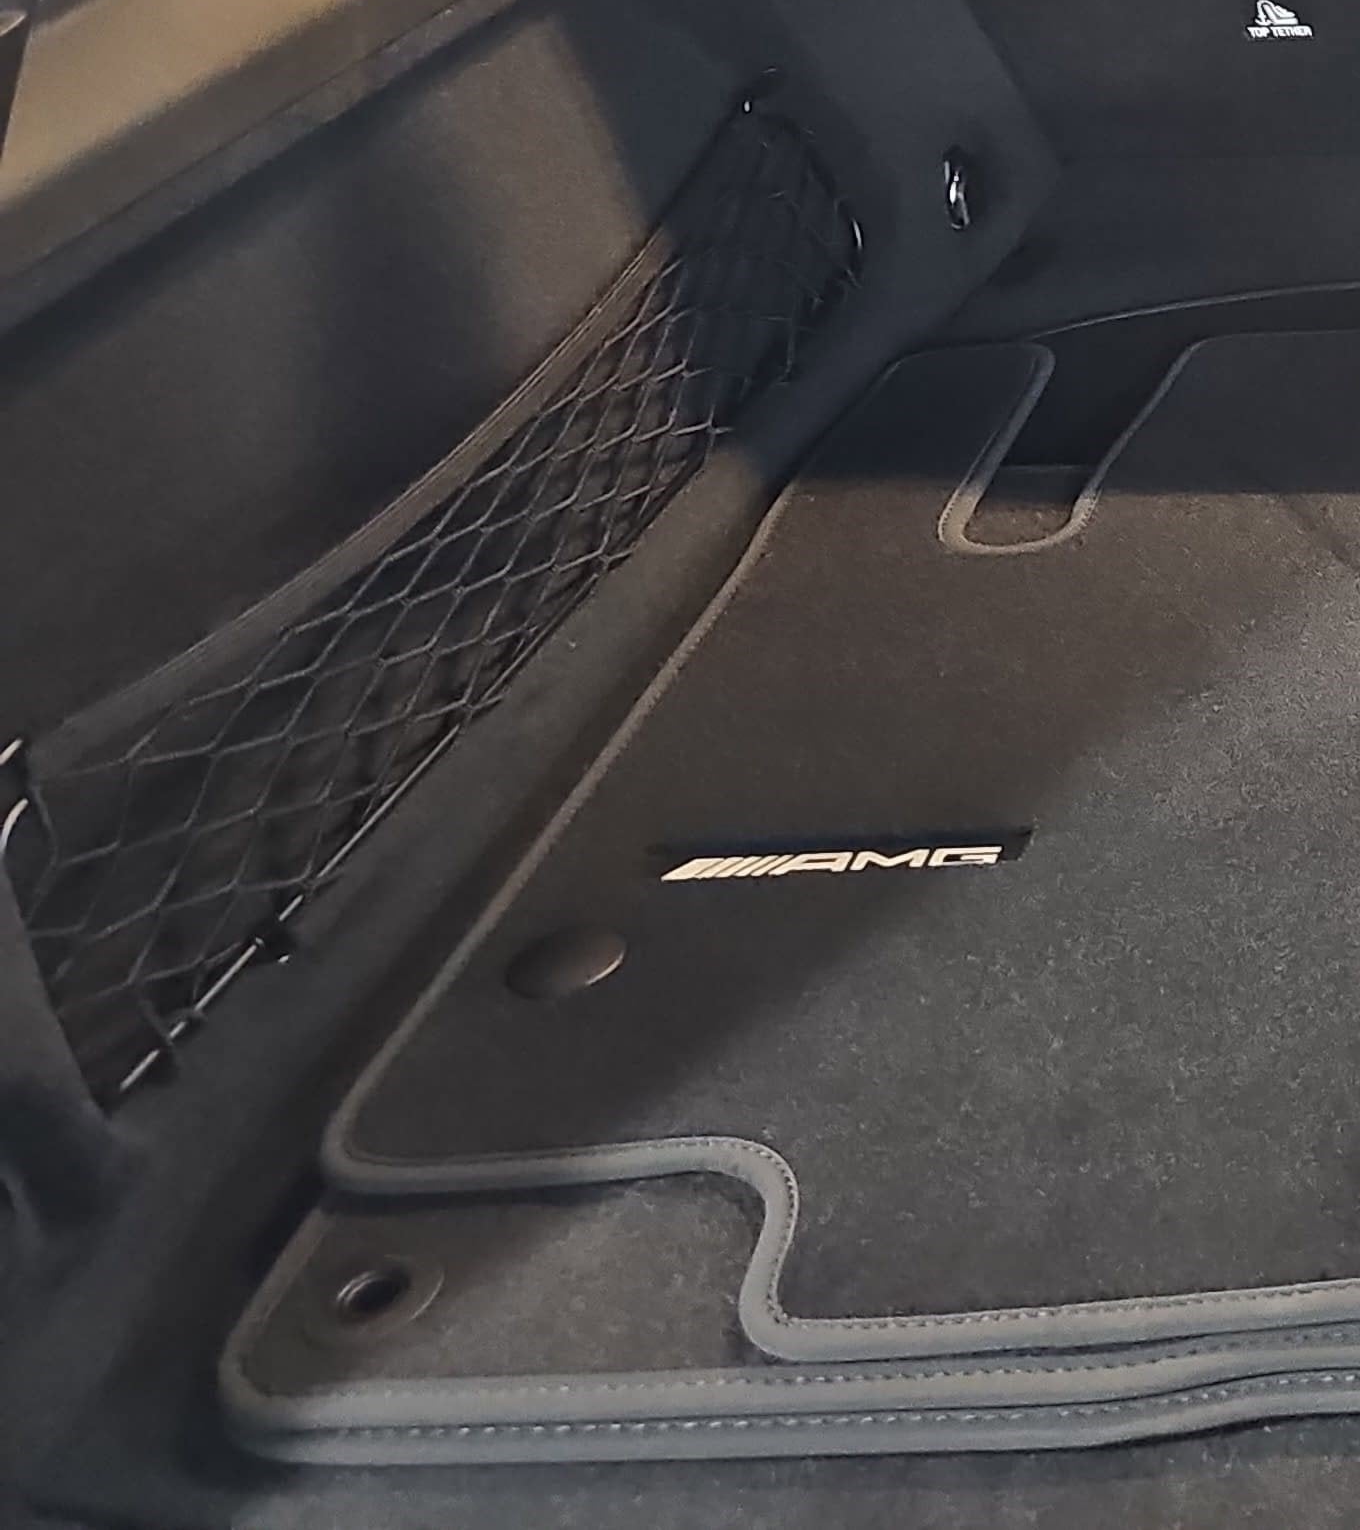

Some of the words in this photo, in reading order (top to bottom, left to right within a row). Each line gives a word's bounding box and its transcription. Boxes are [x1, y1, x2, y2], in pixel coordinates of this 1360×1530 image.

[1246, 26, 1270, 38] TOP
[1270, 25, 1313, 38] TETHER
[770, 845, 1003, 875] AMG
